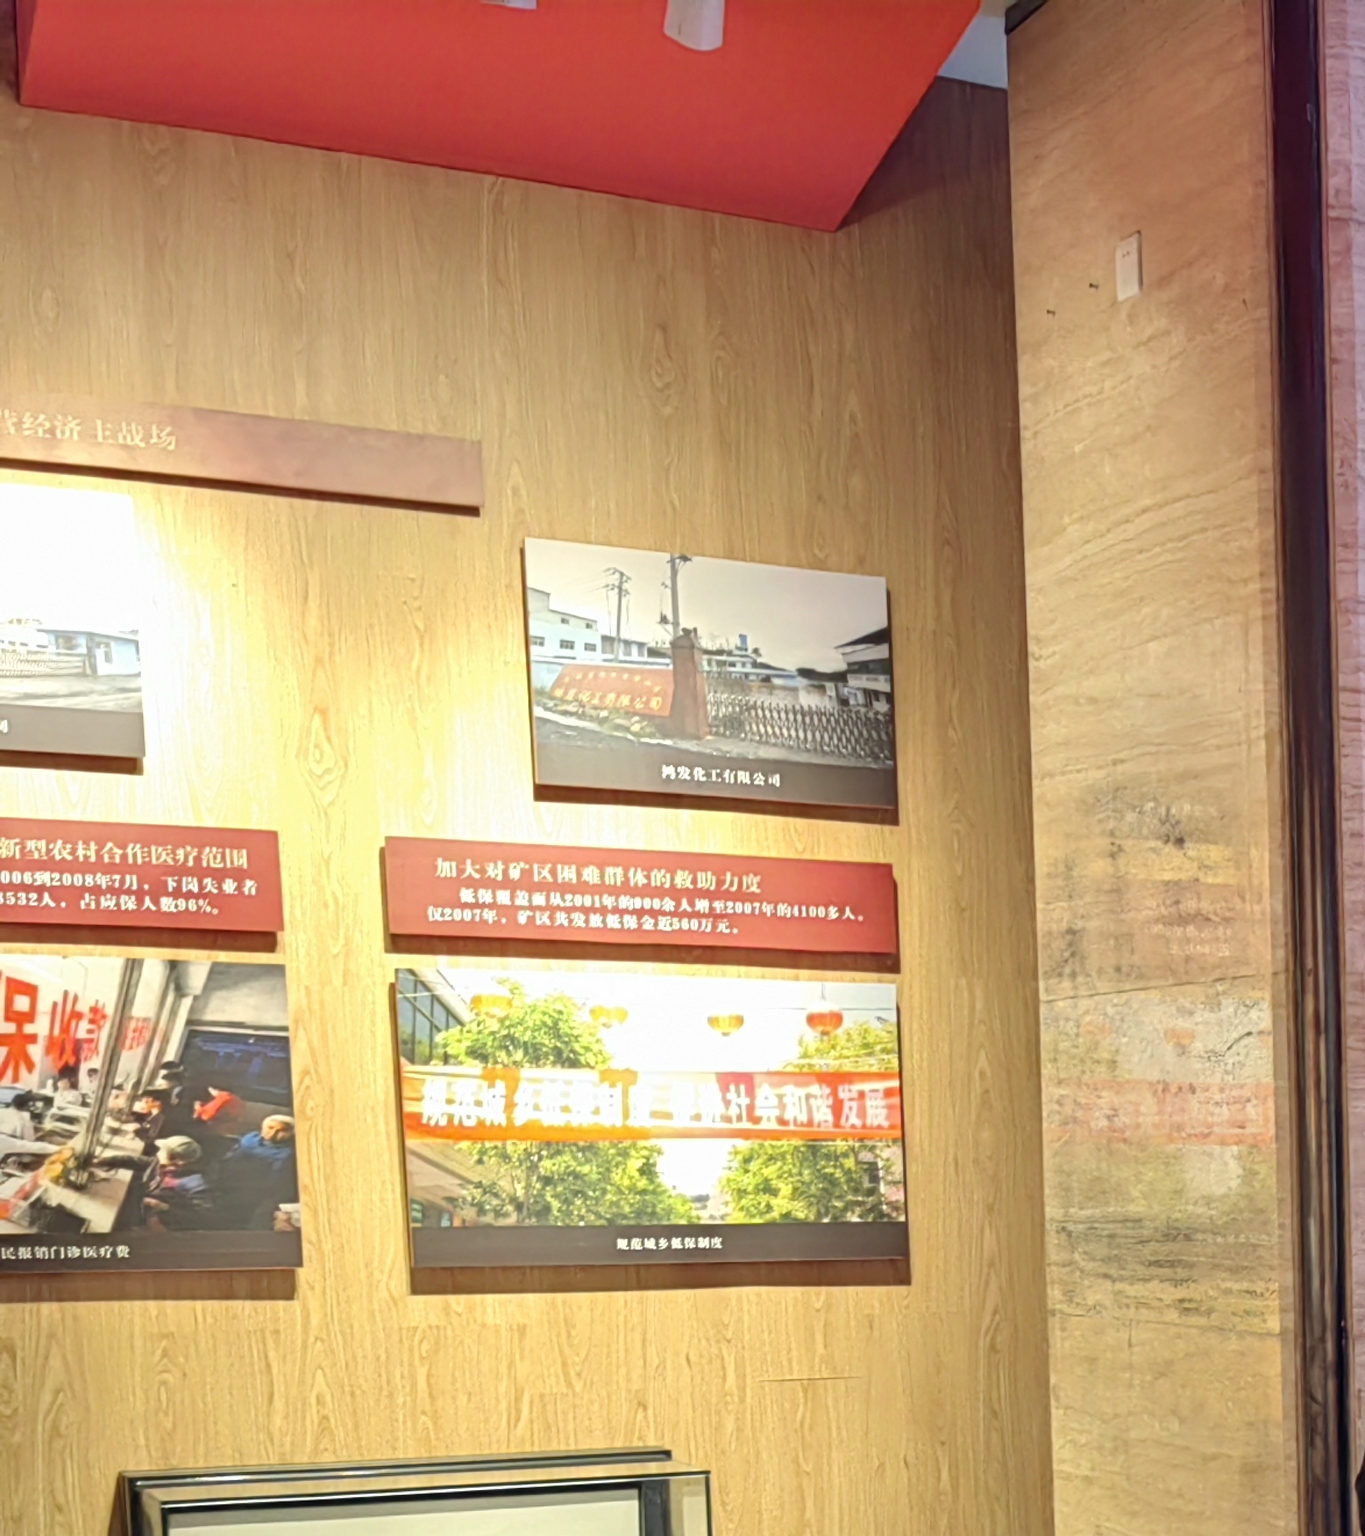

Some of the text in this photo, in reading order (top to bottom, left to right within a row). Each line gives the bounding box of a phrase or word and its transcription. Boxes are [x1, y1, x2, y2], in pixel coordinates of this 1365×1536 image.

[0, 837, 249, 869] 新型农村合作医疗范围
[435, 857, 762, 893] 加大对矿区困难群体的救助力度
[0, 1245, 131, 1259] 民报销门诊医疗费
[616, 1236, 723, 1250] 规范城乡低保制度
